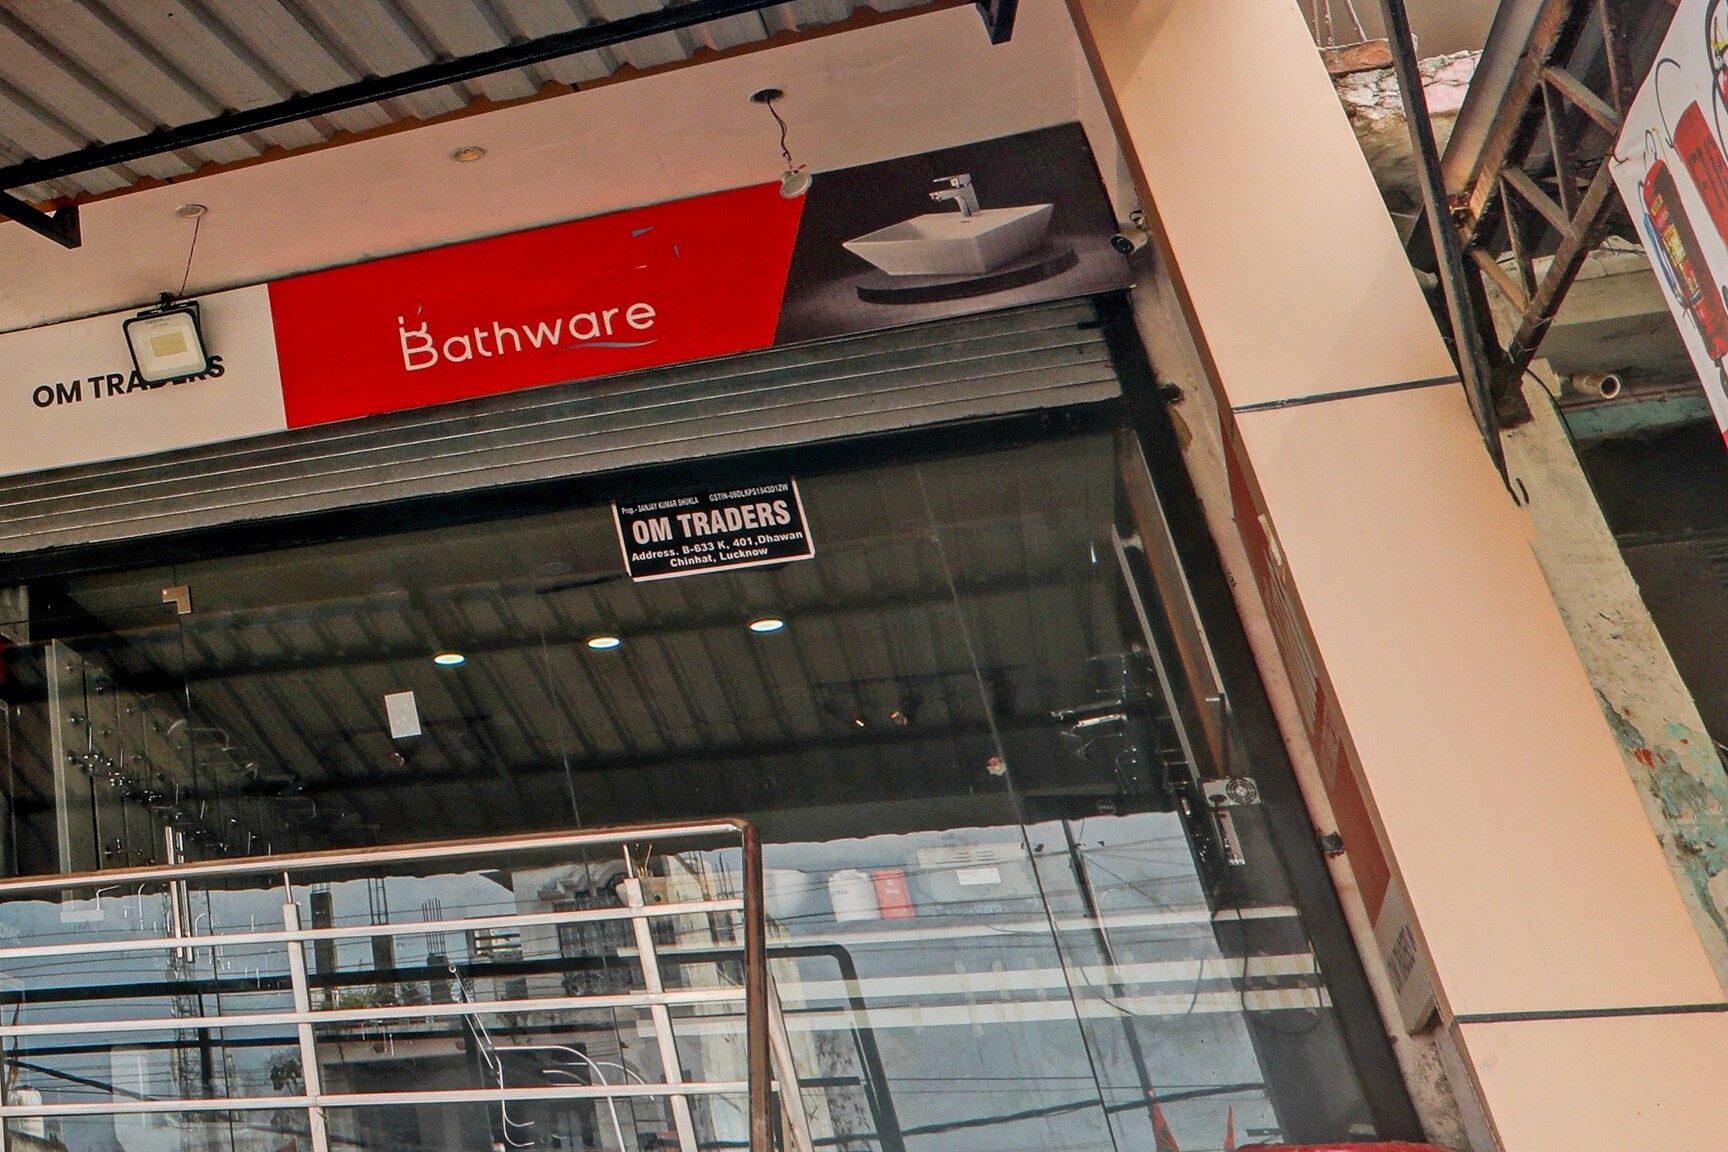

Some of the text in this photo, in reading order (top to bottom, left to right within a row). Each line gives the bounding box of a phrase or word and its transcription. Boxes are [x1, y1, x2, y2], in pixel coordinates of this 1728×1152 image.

[398, 302, 656, 371] Bathware
[32, 355, 225, 408] OM TRAS
[658, 499, 678, 509] KUMAR
[677, 496, 700, 507] SHUKLA
[631, 499, 791, 545] OM TRADERS
[631, 549, 680, 562] Address.
[682, 543, 715, 555] B-633
[669, 546, 769, 568] Chinhat, Lucknow
